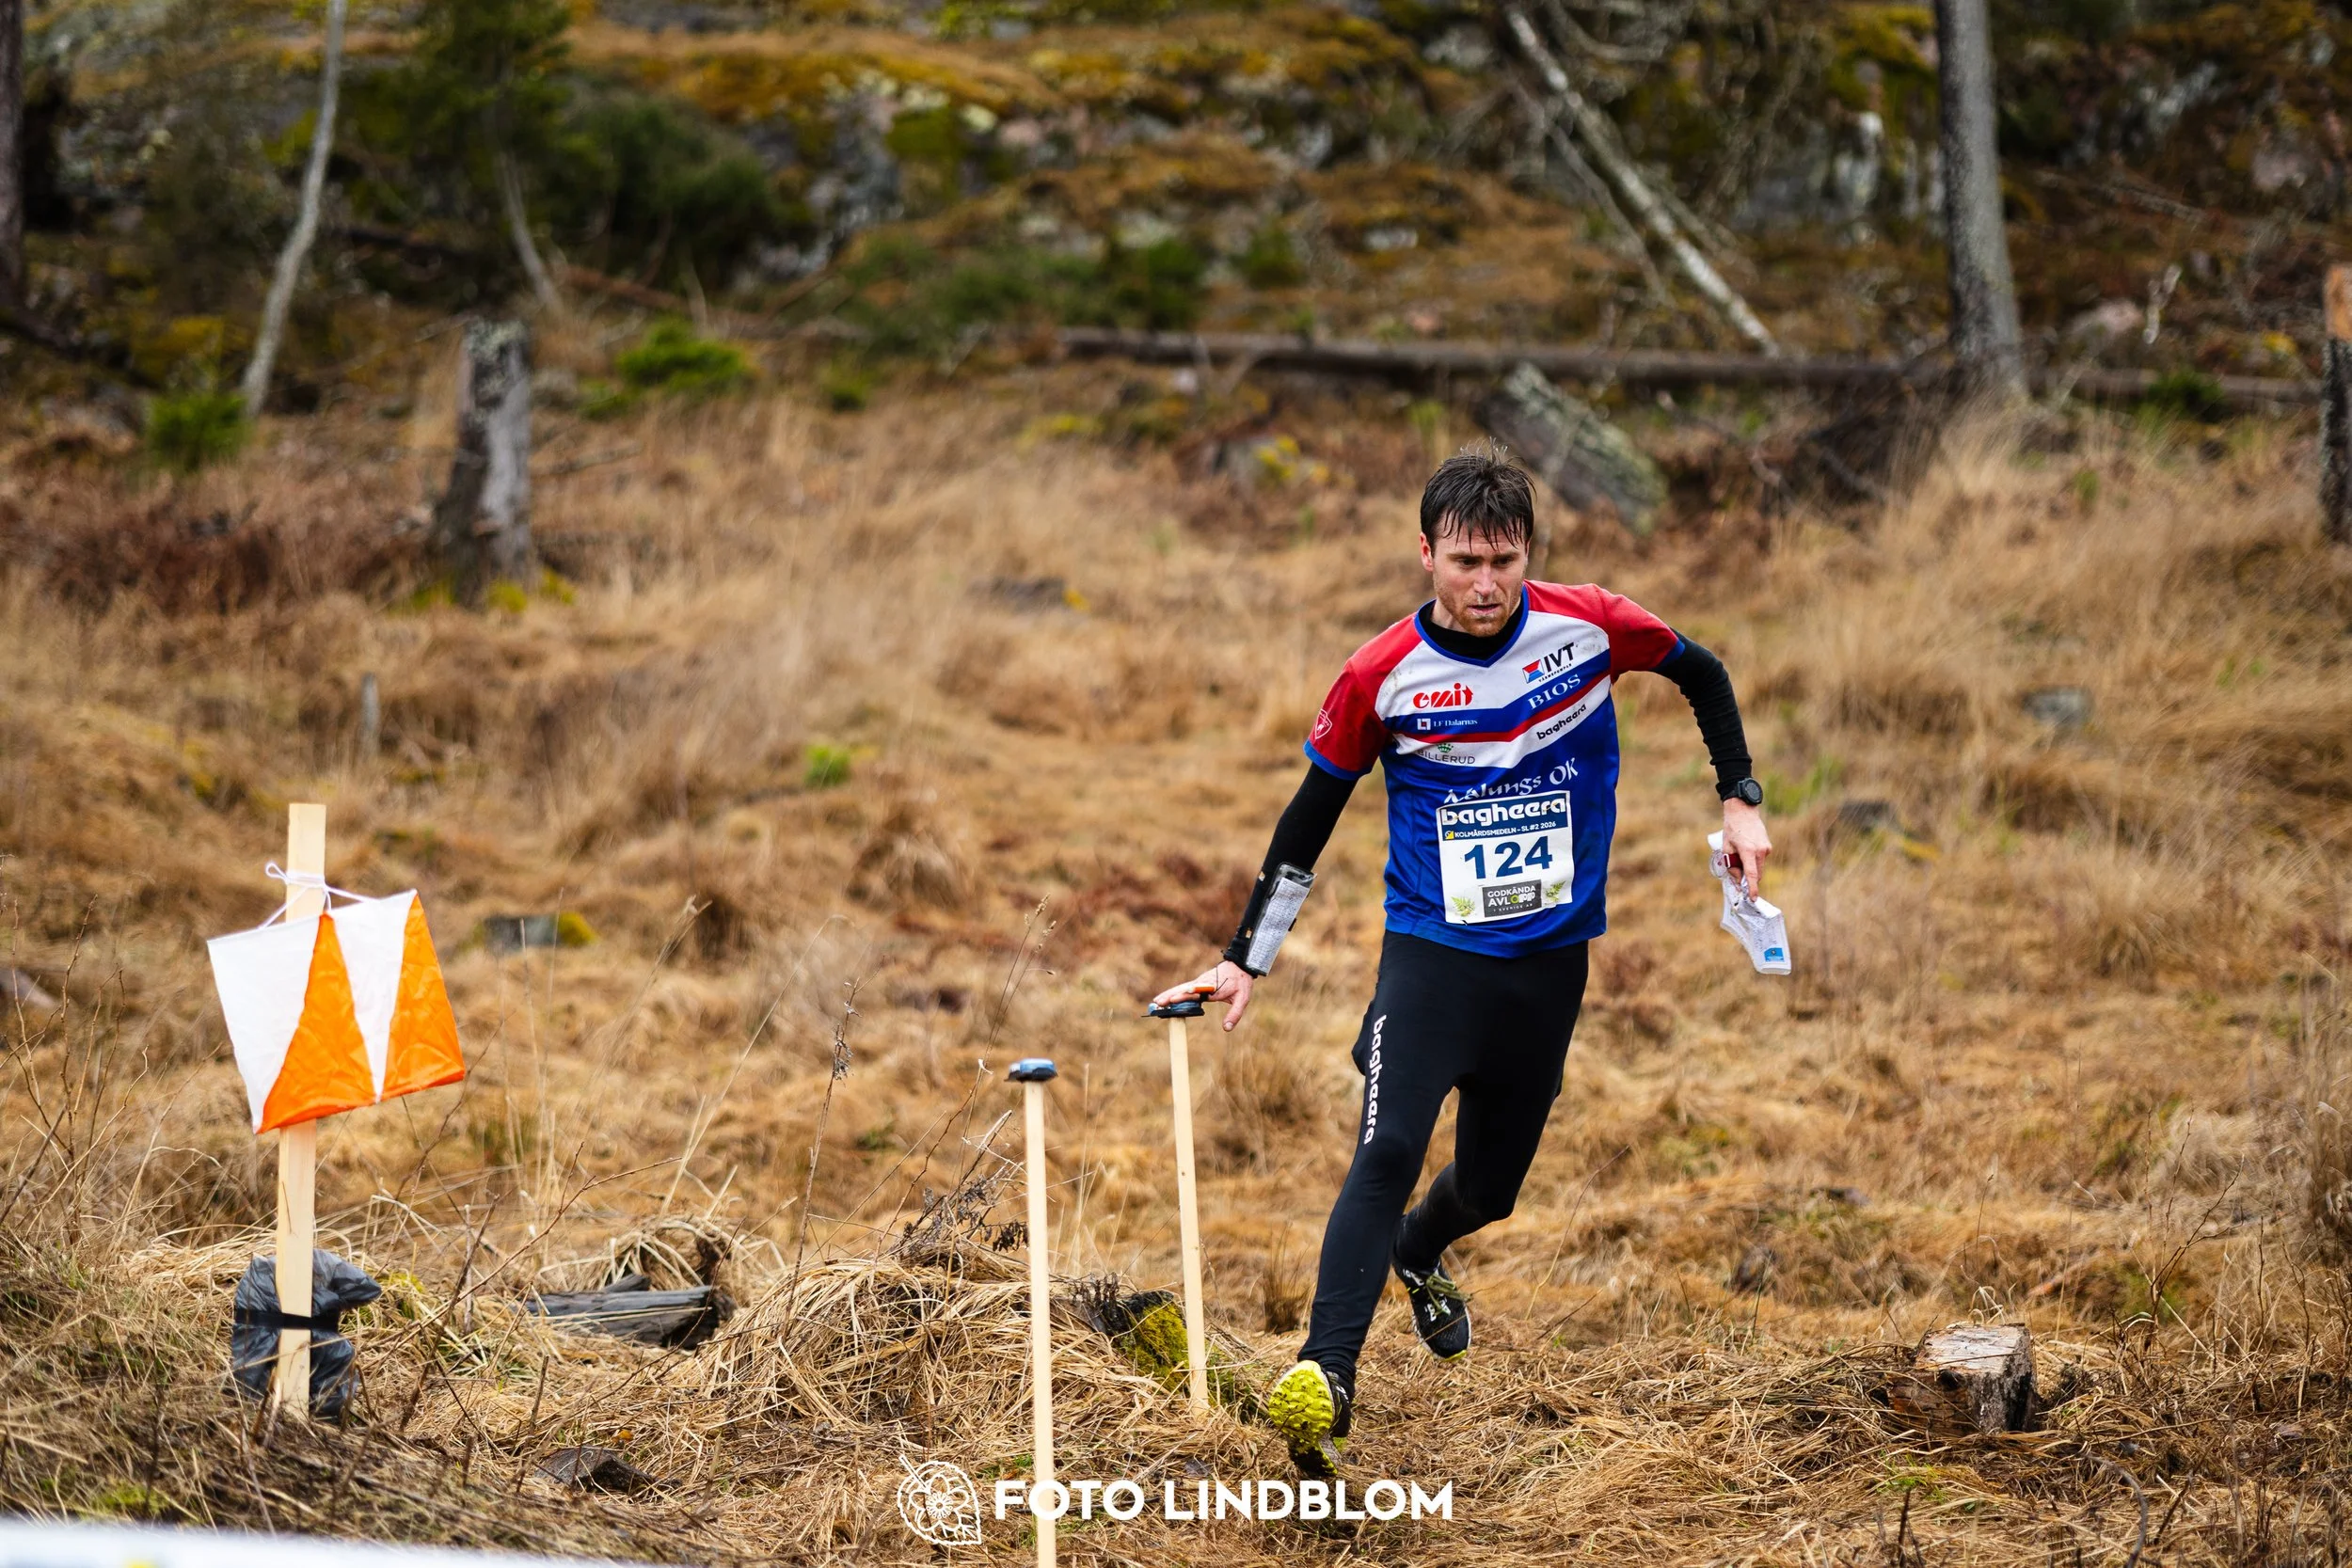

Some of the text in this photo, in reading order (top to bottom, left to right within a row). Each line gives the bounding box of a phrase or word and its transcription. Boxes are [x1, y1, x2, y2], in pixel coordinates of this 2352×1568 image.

[1544, 641, 1574, 673] IVT
[1413, 682, 1473, 708] emit
[1528, 673, 1581, 709] BIOS
[1536, 704, 1586, 740] bagheera
[1417, 749, 1476, 765] BILLERUD
[1549, 757, 1579, 785] OK
[1440, 797, 1566, 827] bagheera
[1454, 827, 1517, 838] KOLMÅRDSMEDELN
[1540, 821, 1557, 830] 2026
[1464, 835, 1553, 879] 124
[1487, 885, 1536, 898] GODKÄNDA
[1363, 1014, 1387, 1145] bagheera
